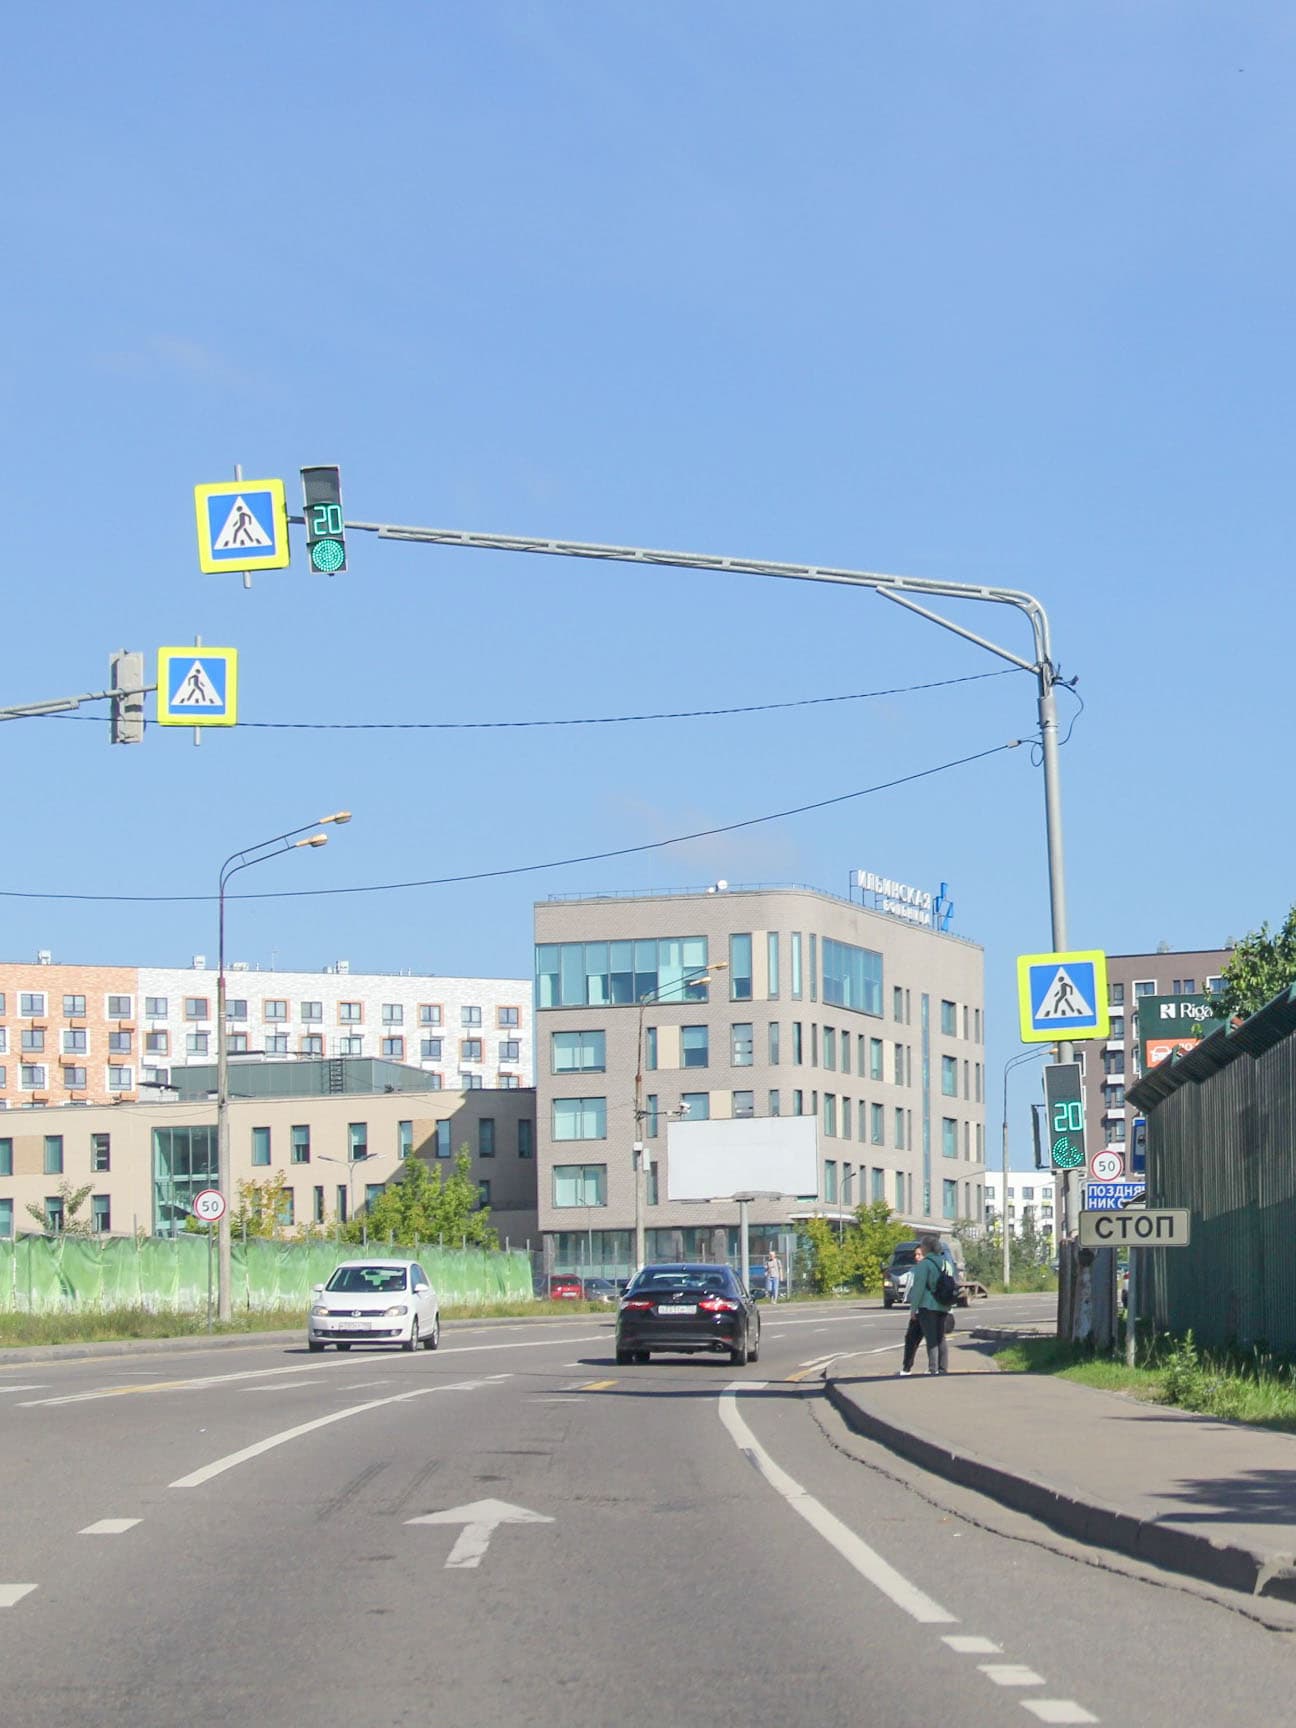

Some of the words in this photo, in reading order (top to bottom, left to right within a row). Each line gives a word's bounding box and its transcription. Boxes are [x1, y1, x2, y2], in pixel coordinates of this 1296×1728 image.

[314, 505, 341, 535] 20
[1054, 1102, 1083, 1132] 20
[1098, 1160, 1116, 1172] 50
[1088, 1186, 1146, 1199] ПОЗДНЯ
[202, 1200, 219, 1212] 50
[1095, 1216, 1173, 1238] СТОП
